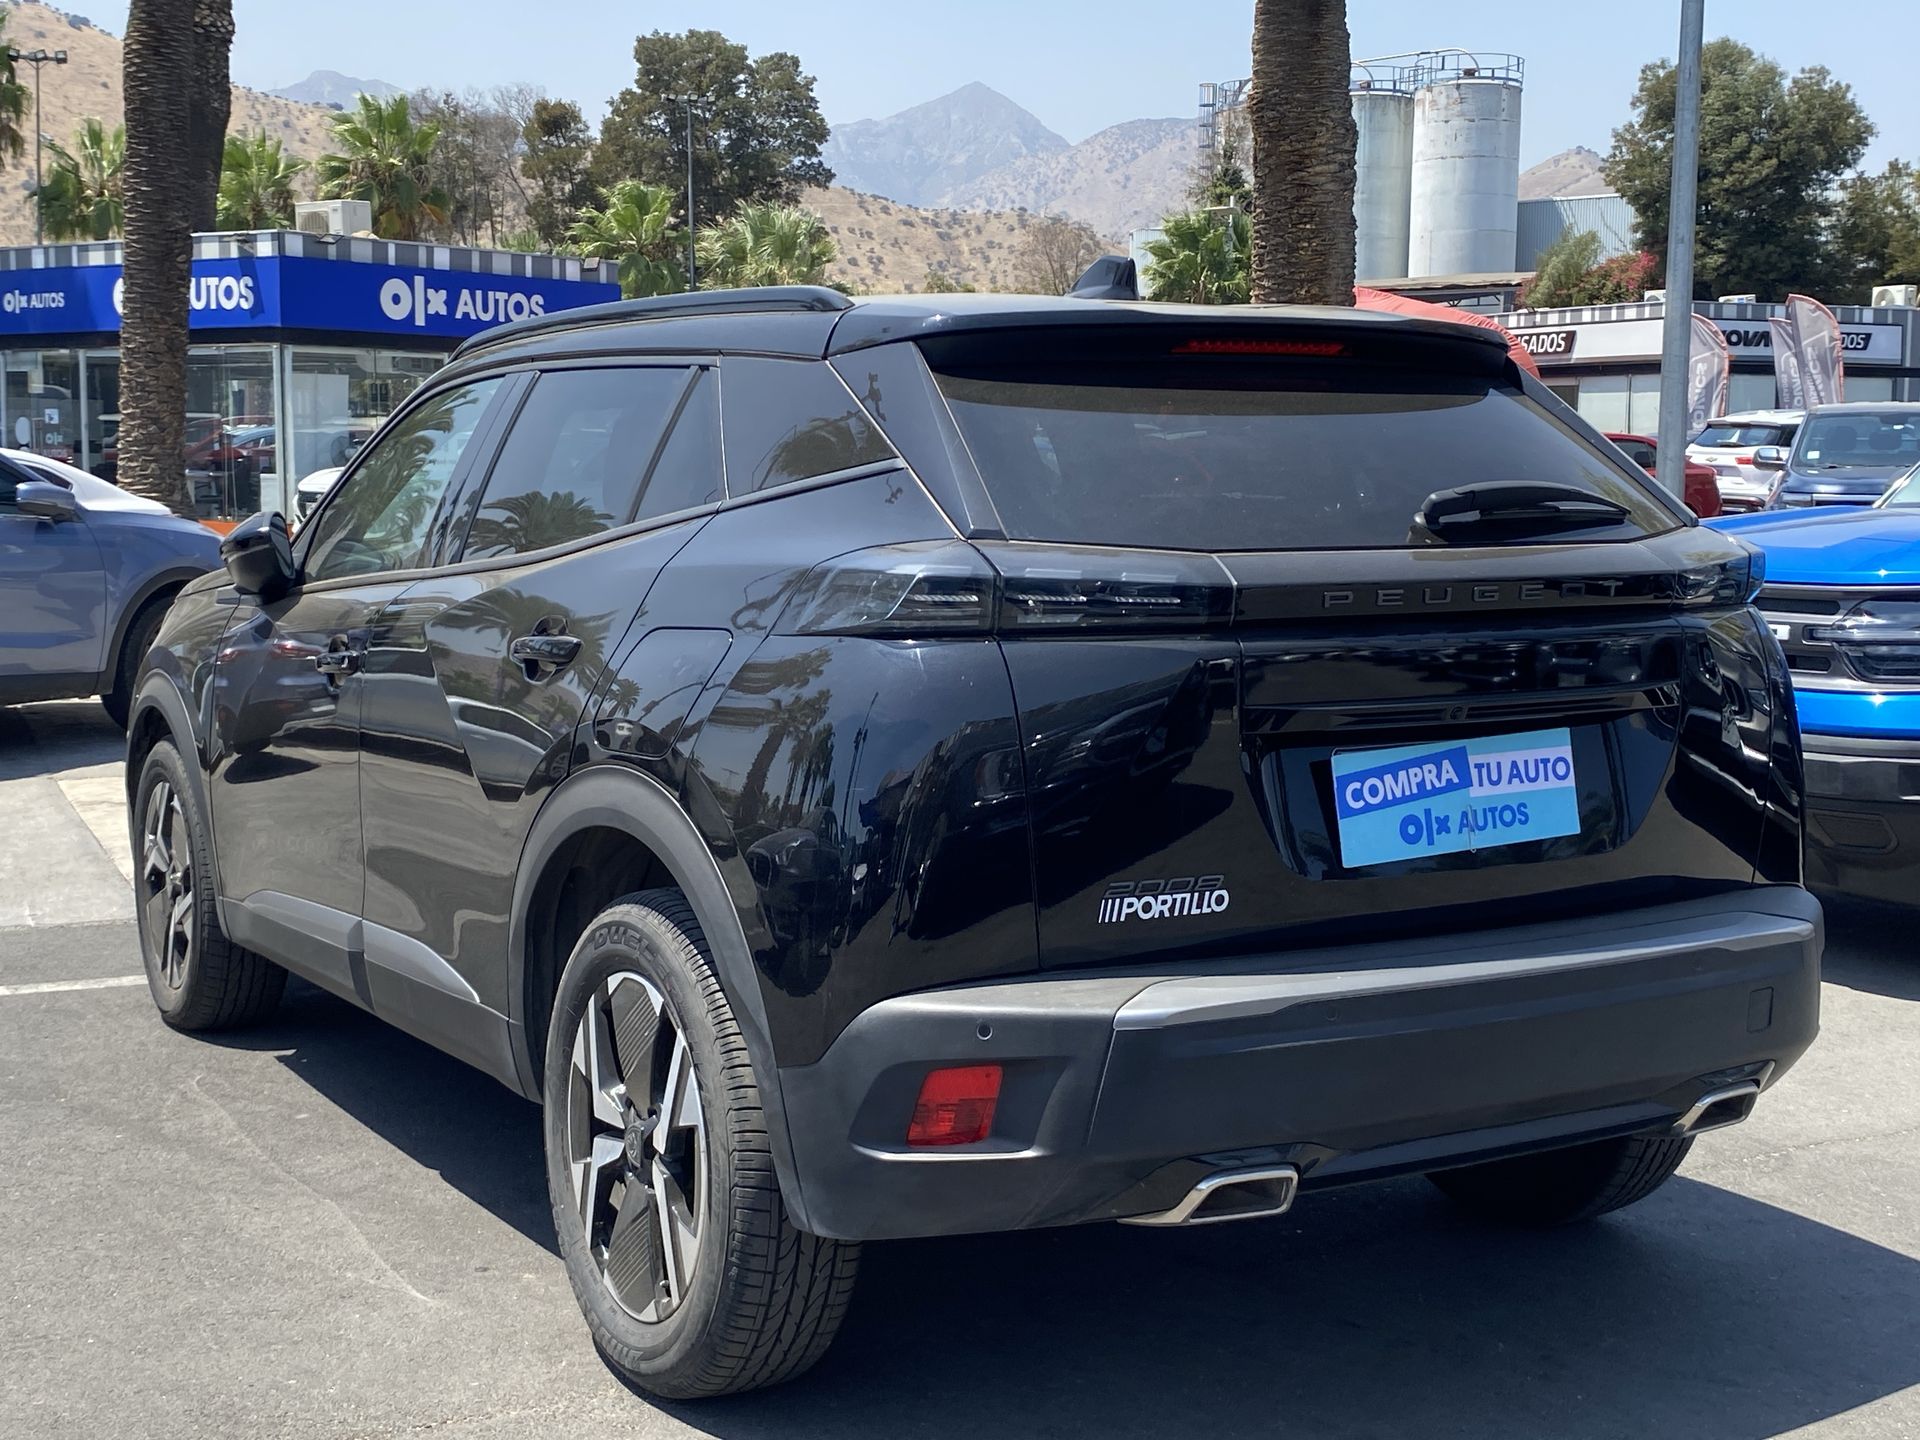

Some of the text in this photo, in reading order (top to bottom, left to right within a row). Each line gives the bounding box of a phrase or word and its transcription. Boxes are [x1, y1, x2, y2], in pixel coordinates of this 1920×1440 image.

[29, 292, 65, 308] AUTOS
[189, 276, 255, 311] UTOS
[455, 288, 545, 323] AUTOS
[1518, 332, 1567, 354] SADOS
[1721, 329, 1774, 348] OVA
[1323, 580, 1624, 608] PEUGEOT
[1345, 756, 1571, 809] COMPRA TU AUTO
[1457, 802, 1530, 835] AUTOS
[1104, 875, 1225, 898] 2008
[1119, 889, 1230, 922] PORTILLO
